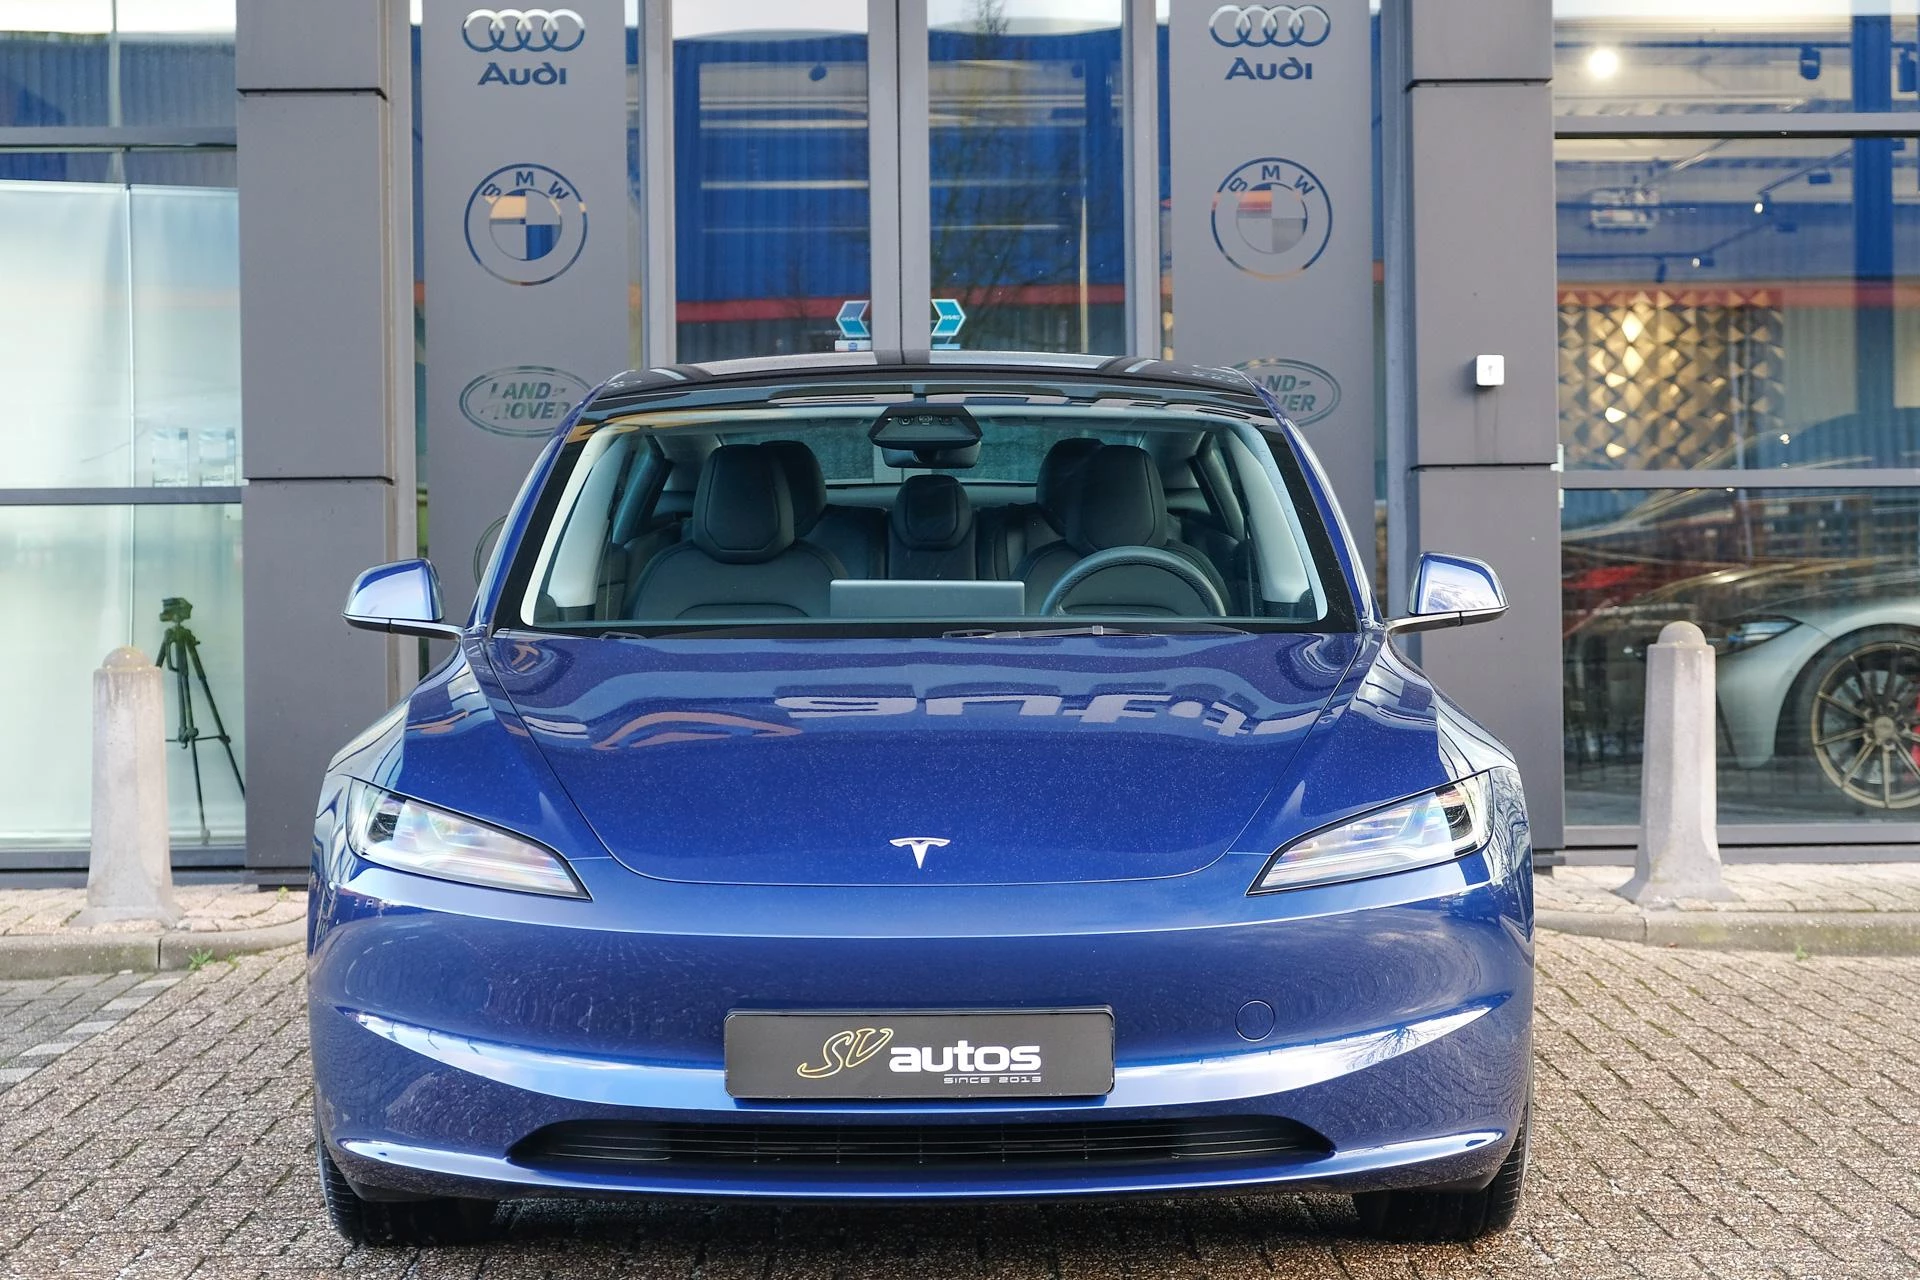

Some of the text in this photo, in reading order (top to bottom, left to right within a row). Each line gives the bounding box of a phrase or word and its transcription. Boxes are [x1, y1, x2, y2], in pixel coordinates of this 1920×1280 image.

[477, 62, 567, 86] Audi
[1224, 57, 1313, 80] Audi
[481, 171, 569, 204] BMW
[1228, 165, 1316, 198] BMW
[1255, 375, 1297, 392] ND
[796, 1027, 1042, 1079] SV autos
